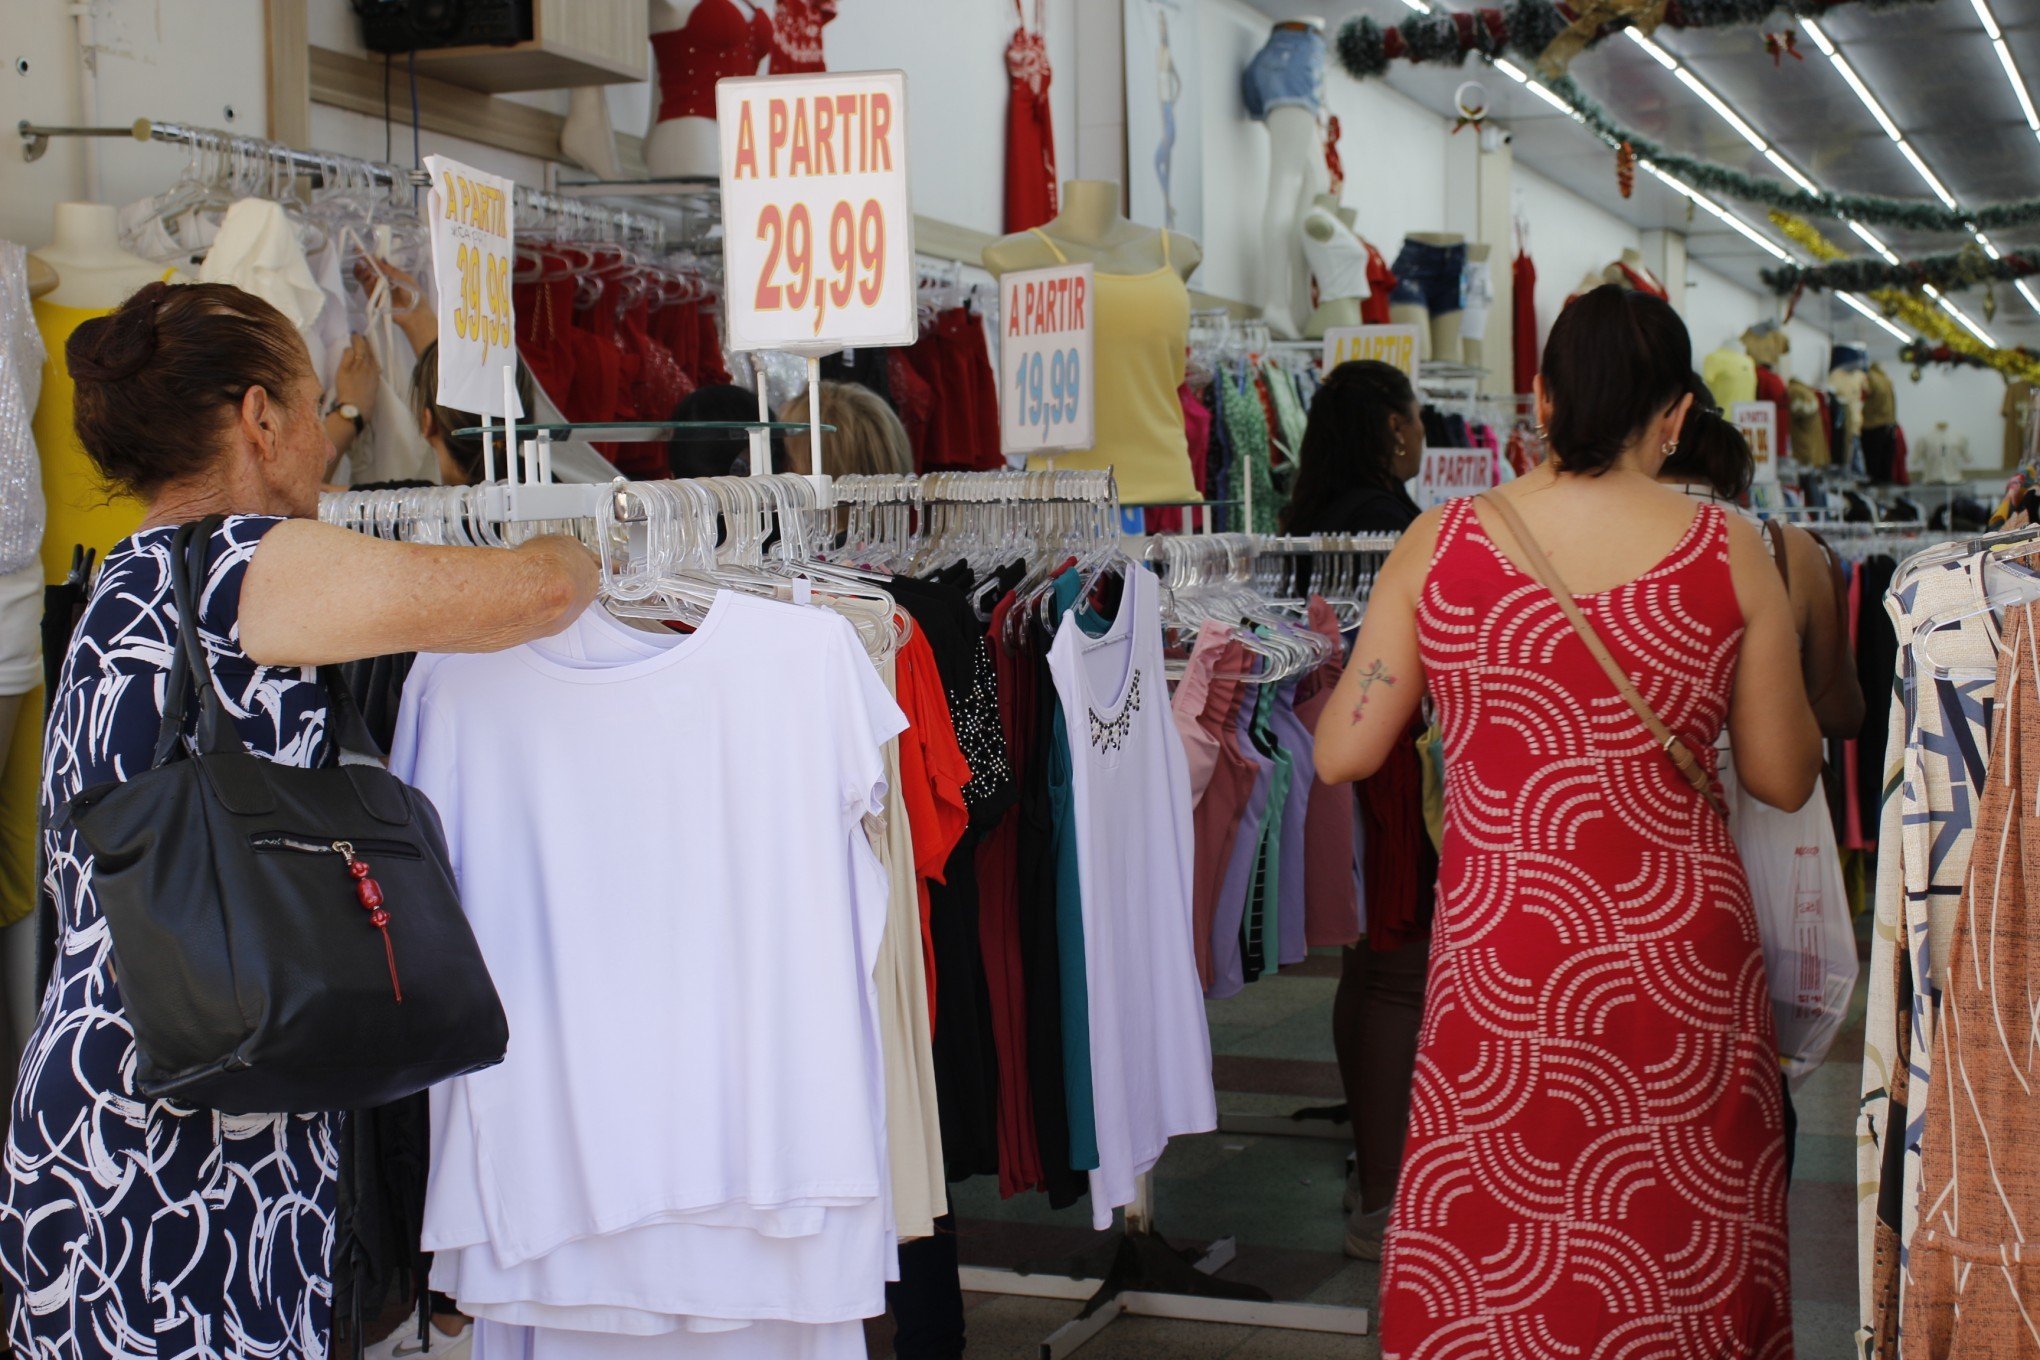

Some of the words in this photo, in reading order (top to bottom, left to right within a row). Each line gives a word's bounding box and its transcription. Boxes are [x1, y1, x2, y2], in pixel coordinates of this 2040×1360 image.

[734, 100, 758, 179] A
[767, 92, 893, 178] PARTIR
[443, 171, 457, 221] A
[454, 243, 509, 366] 39,99
[755, 198, 886, 336] 29,99
[1009, 285, 1021, 336] A
[1025, 276, 1085, 335] PARTIR
[1016, 348, 1079, 443] 19,99
[1423, 456, 1433, 486] A
[1437, 456, 1487, 486] PARTIR
